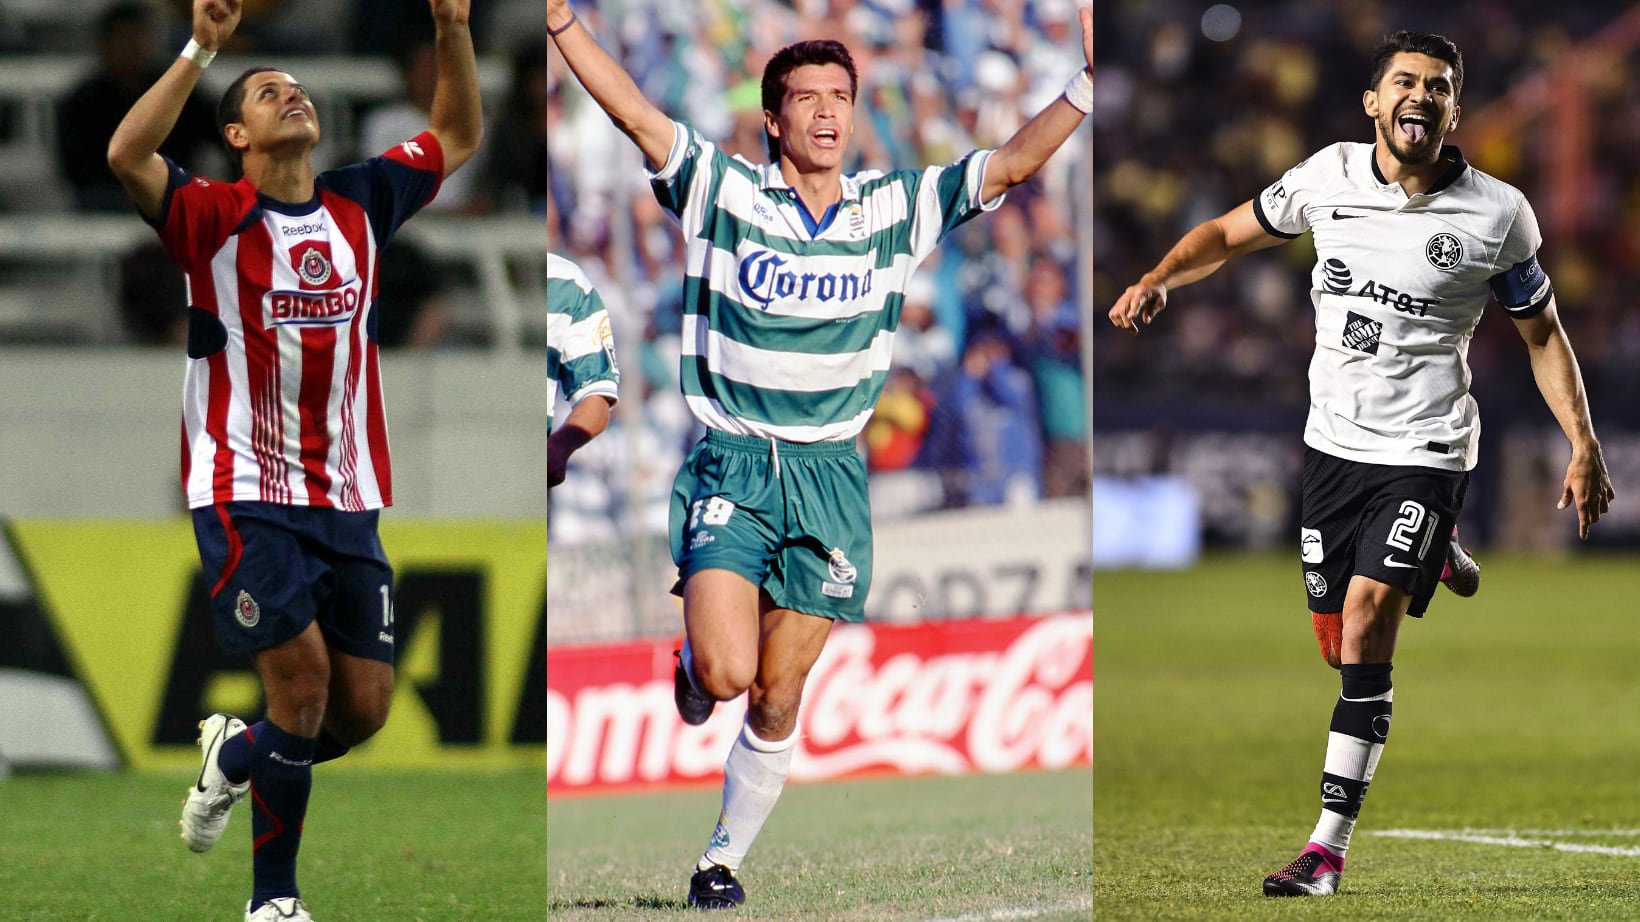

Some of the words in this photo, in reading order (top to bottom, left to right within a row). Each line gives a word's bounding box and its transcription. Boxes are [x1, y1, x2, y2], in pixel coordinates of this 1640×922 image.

[281, 221, 327, 236] Reebok
[739, 251, 872, 311] Corona
[271, 287, 357, 319] BIMBO
[1359, 280, 1440, 317] AT&T
[1348, 319, 1364, 332] THE
[1386, 500, 1440, 561] 21
